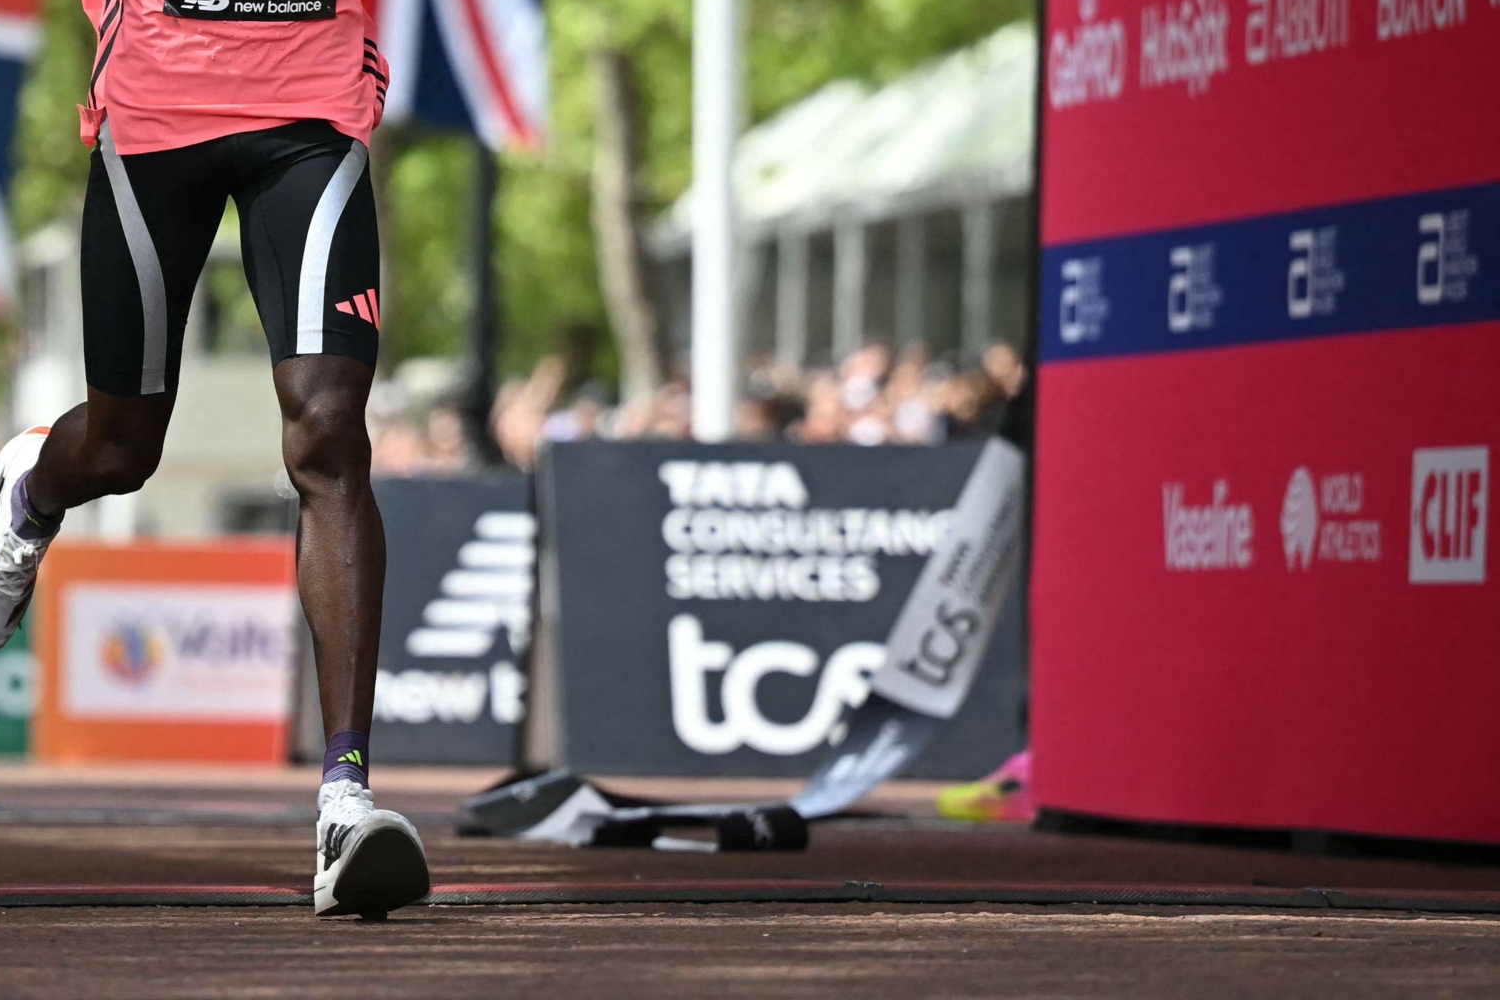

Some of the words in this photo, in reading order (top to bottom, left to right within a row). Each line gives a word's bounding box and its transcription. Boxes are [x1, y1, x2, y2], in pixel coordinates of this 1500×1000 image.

[234, 1, 264, 13] new
[268, 0, 322, 13] balance
[660, 461, 807, 508] TATA
[1162, 480, 1254, 571] Vaseline
[1420, 470, 1481, 563] CLIF
[665, 553, 880, 602] SERVICES
